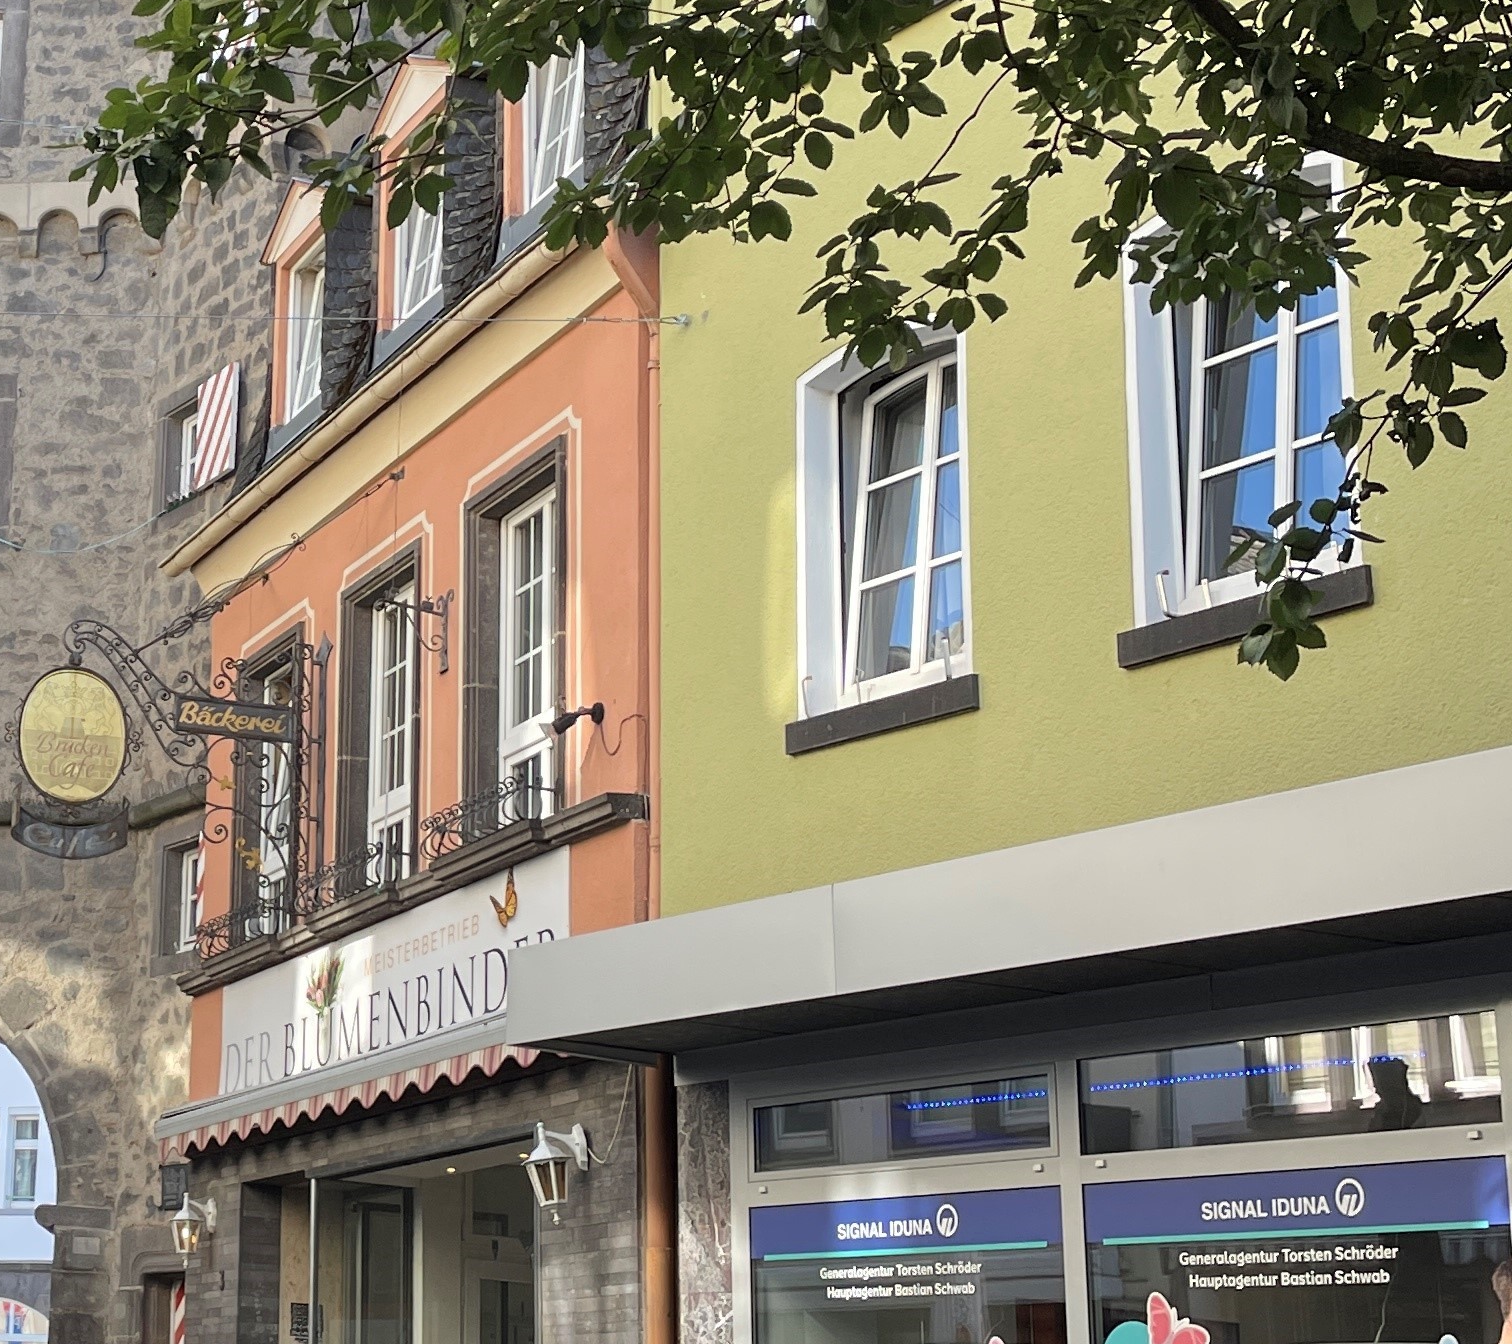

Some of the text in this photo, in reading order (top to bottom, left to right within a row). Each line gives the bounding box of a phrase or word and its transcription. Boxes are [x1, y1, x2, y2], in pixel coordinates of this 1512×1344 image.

[179, 700, 287, 735] Bäckerei
[364, 914, 481, 976] MEISTERBETRIEB
[223, 928, 556, 1094] DER BLUMENBIND
[1201, 1196, 1330, 1221] SIGNAL IDUNA
[837, 1219, 933, 1240] SIGNAL IDUNA
[1179, 1244, 1399, 1268] Generalagentur Torsten Schröder
[819, 1260, 983, 1281] Generalagentur Torsten Schröder
[1189, 1268, 1391, 1291] Hauptagentur Bastian Schwab
[826, 1281, 976, 1301] Hauptagentur Bastian Schwab
